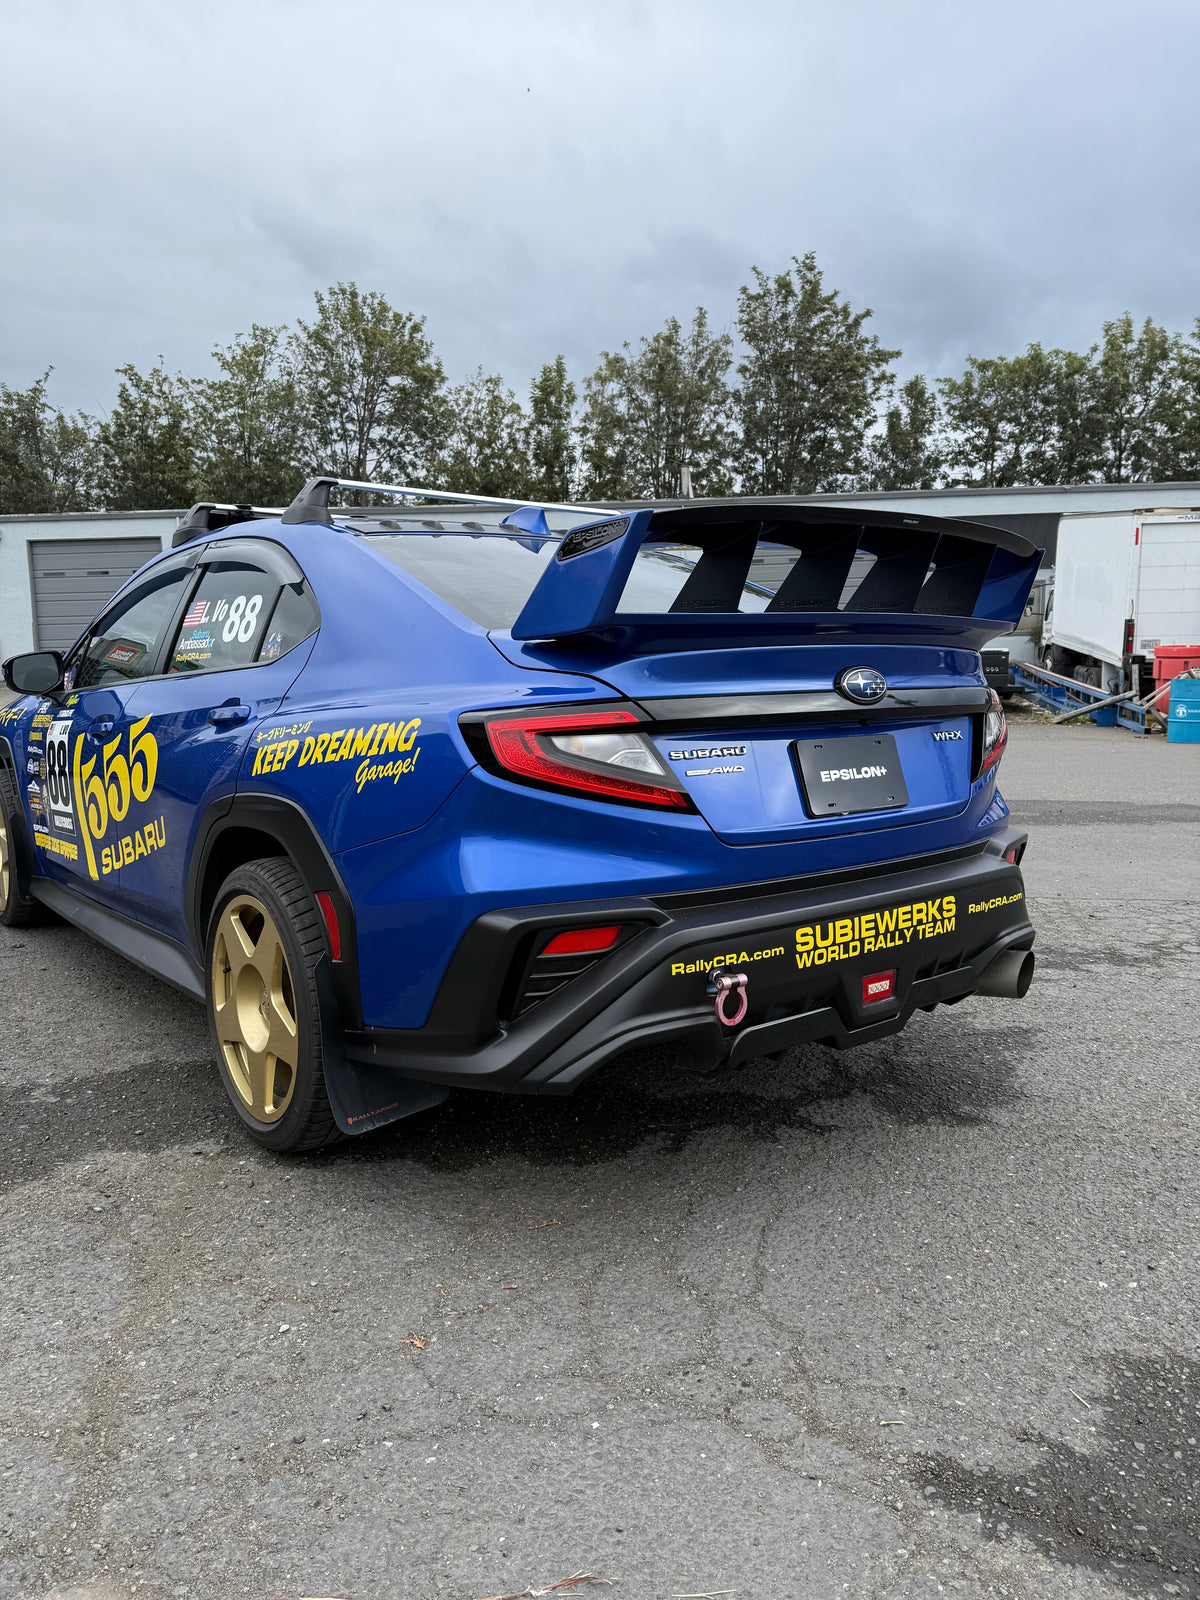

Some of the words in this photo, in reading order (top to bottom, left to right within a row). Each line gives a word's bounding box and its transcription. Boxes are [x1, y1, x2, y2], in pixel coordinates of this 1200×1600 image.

[222, 594, 263, 643] 88
[176, 652, 212, 663] RallyCRA.com
[252, 739, 300, 777] KEEP
[297, 717, 422, 768] DREAMING
[669, 746, 748, 762] SUBARU
[932, 730, 963, 742] WRX
[46, 740, 71, 807] 88
[81, 712, 159, 840] 555
[355, 747, 421, 794] Garage!
[710, 765, 746, 775] AWD
[820, 764, 888, 783] EPSILON+
[101, 815, 167, 876] SUBARU
[794, 895, 957, 952] SUBIEWERKS
[967, 892, 1024, 915] RallyCRA.com
[670, 945, 785, 976] RallyCRA.com
[795, 940, 860, 970] WORLD
[864, 928, 914, 955] RALLY
[916, 916, 957, 941] TEAM
